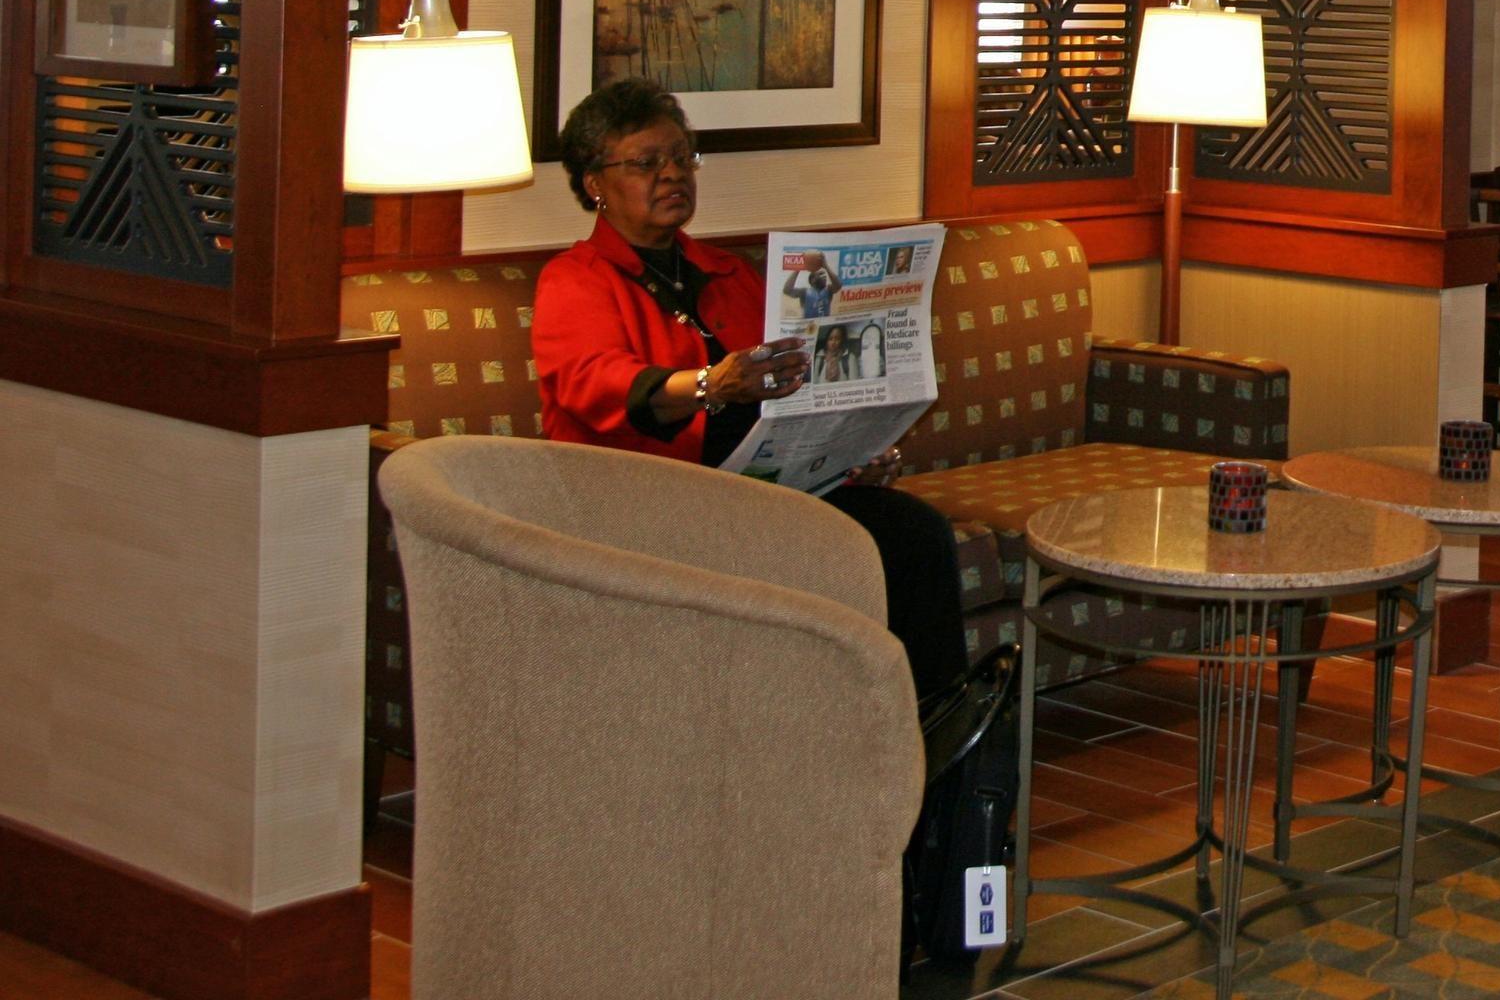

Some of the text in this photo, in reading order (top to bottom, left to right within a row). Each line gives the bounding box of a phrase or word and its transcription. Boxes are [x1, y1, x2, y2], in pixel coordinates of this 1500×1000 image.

[784, 255, 804, 265] NCAA
[856, 251, 882, 265] USA
[841, 264, 883, 279] TODAY
[841, 283, 923, 301] Madness preview
[888, 308, 908, 318] Fraud
[887, 318, 917, 329] found in
[887, 329, 920, 339] Medicare
[887, 340, 913, 351] billings
